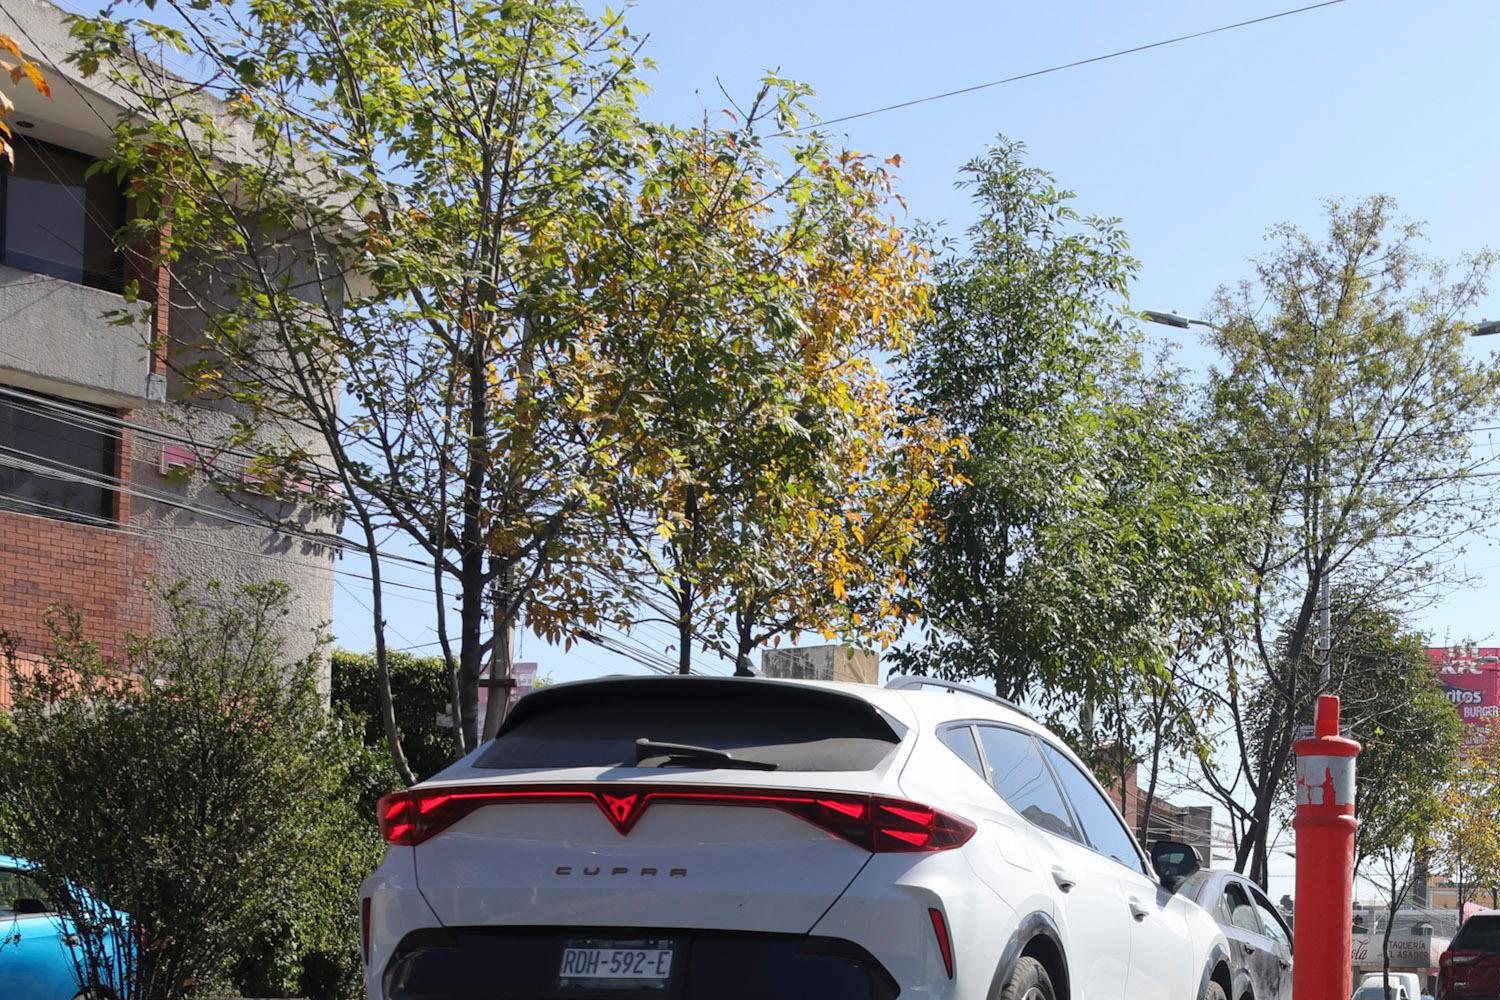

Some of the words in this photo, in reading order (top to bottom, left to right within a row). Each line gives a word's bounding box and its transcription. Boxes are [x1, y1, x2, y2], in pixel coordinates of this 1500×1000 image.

[1463, 705, 1499, 718] BURGER
[555, 866, 688, 878] CUPRA
[1388, 939, 1426, 951] TAQUERÍA
[562, 949, 671, 976] RDH-592-E
